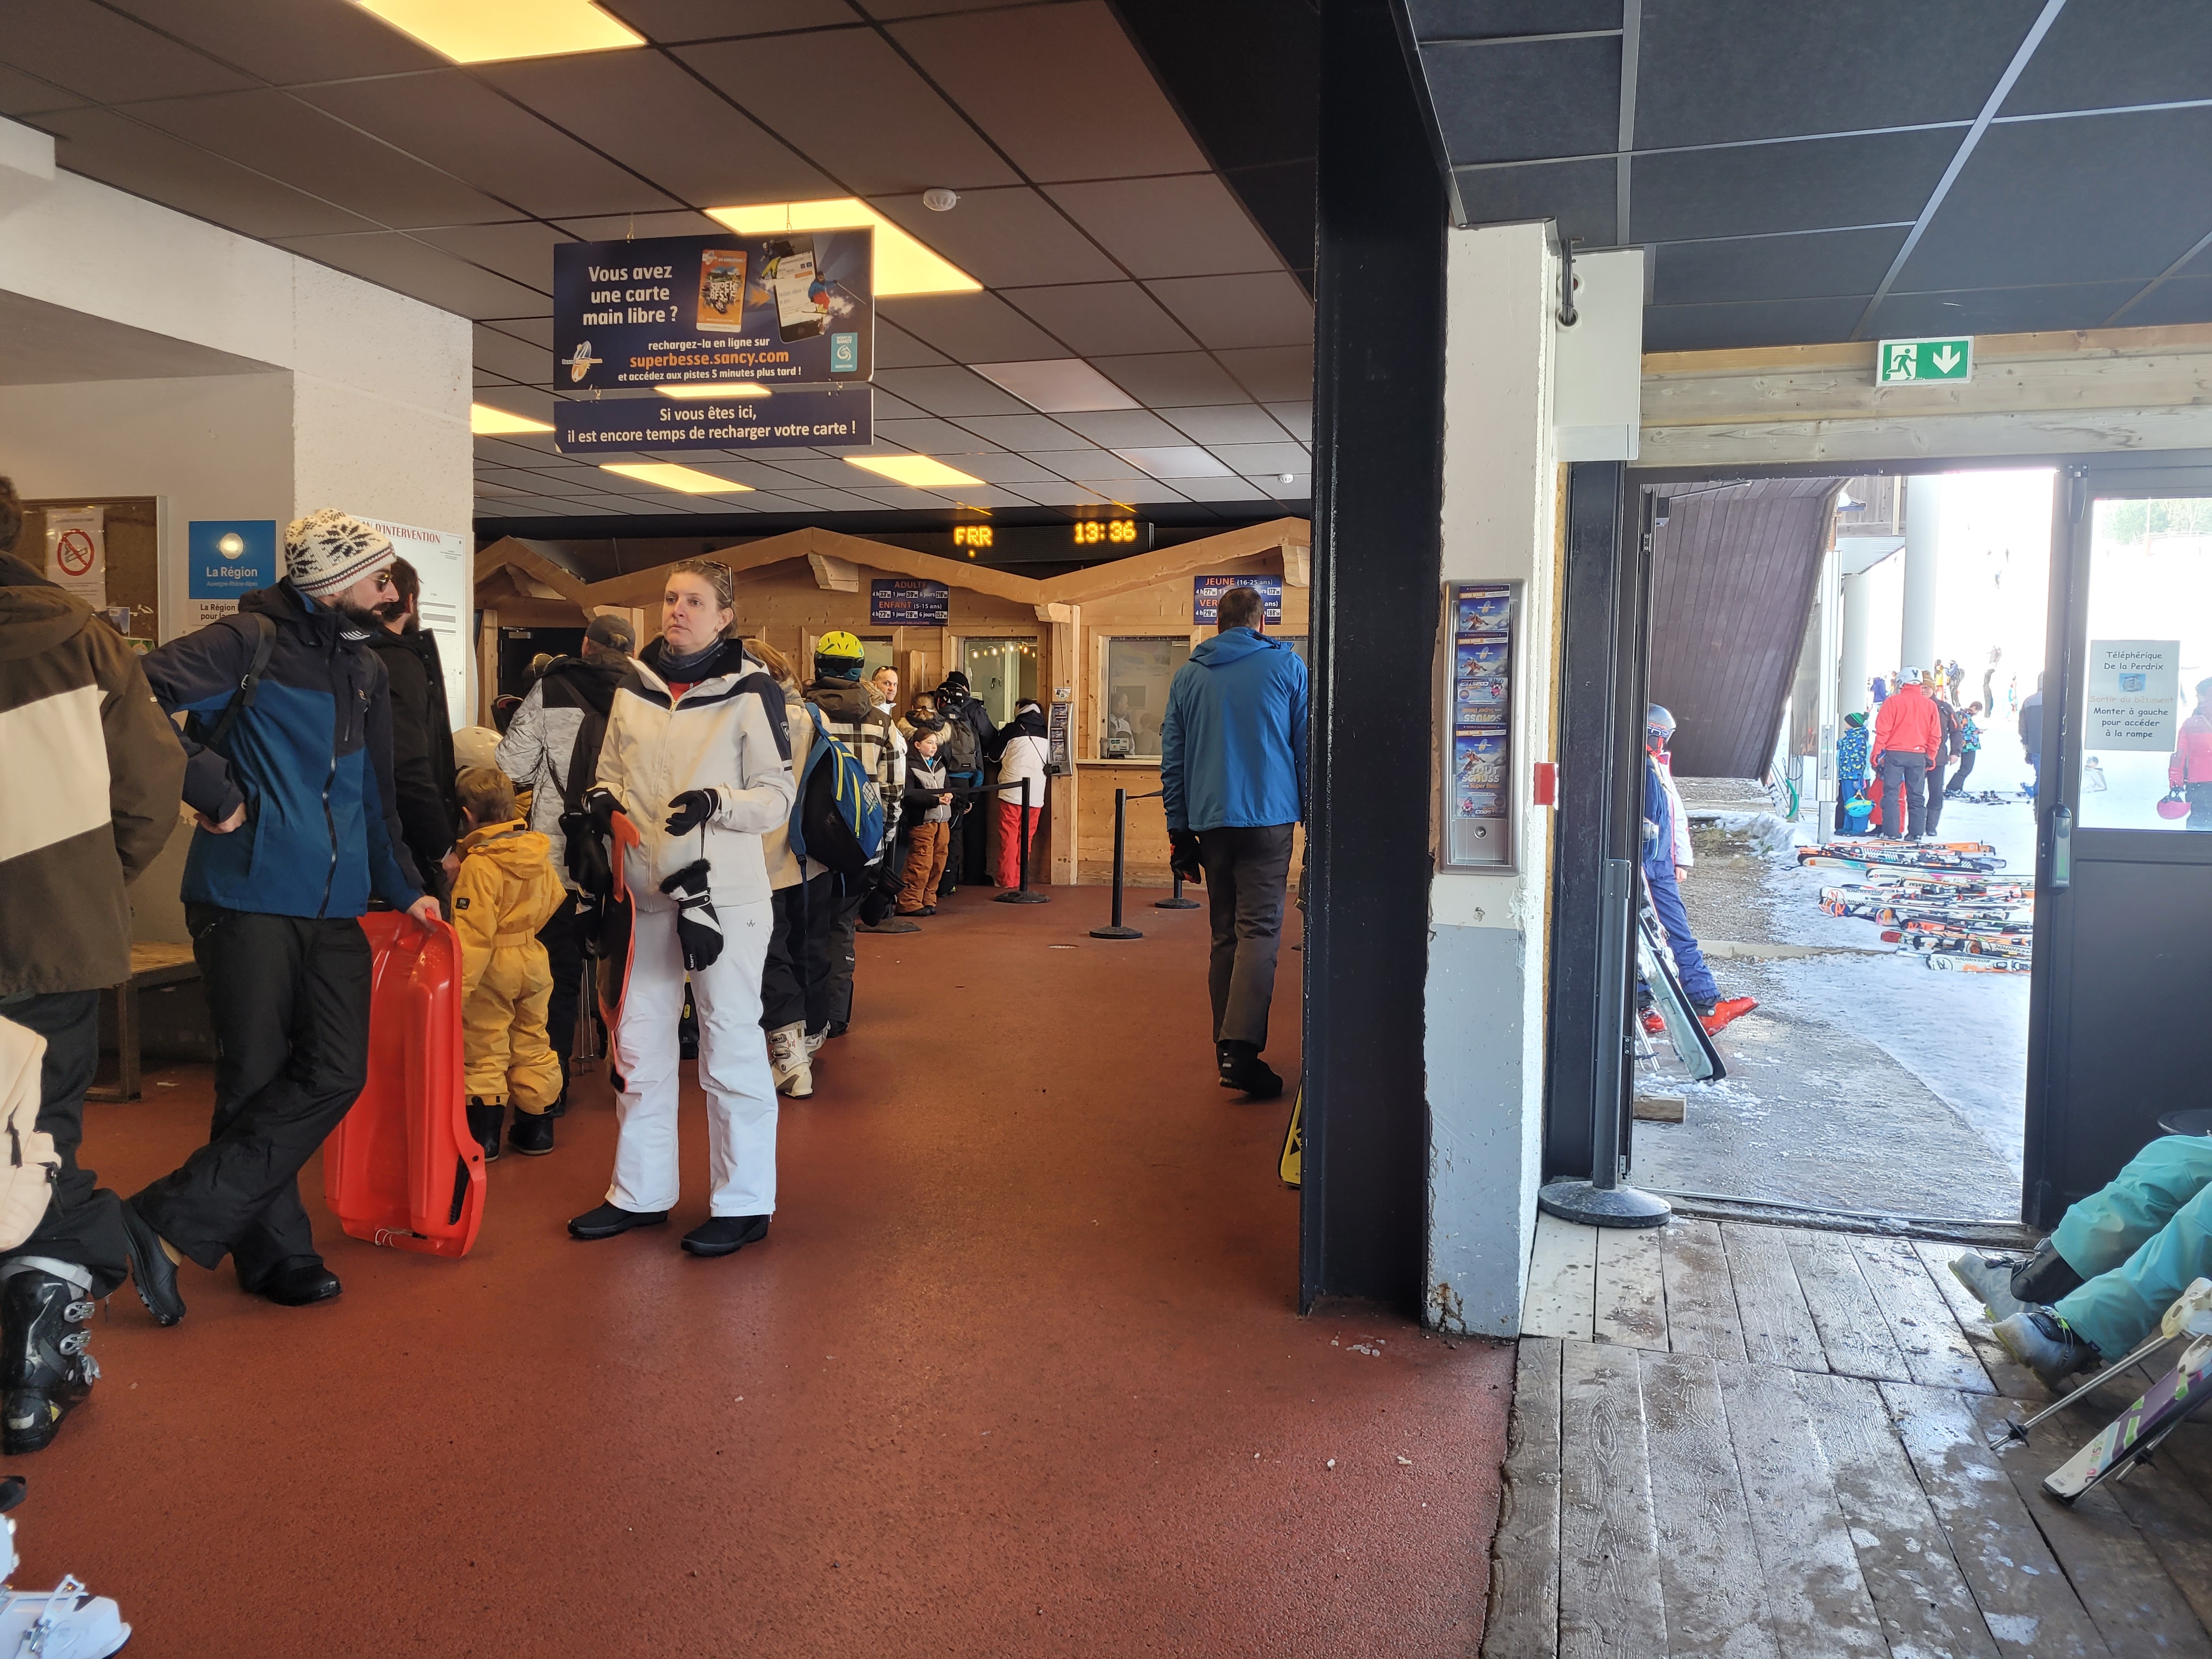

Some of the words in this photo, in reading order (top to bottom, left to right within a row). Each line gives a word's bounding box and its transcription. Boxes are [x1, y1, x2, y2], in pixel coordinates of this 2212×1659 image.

[588, 266, 628, 282] Vous
[633, 266, 672, 280] avez
[711, 281, 738, 291] SUPER
[591, 290, 621, 303] une
[625, 286, 670, 302] carte
[710, 290, 737, 302] BESSE
[583, 308, 623, 325] main
[628, 307, 665, 324] libre
[670, 306, 678, 321] ?
[648, 338, 711, 351] rechargez-la
[713, 341, 726, 349] en
[728, 338, 752, 349] ligne
[754, 337, 770, 347] sur
[630, 351, 789, 370] superbesse.sancy.com
[618, 373, 628, 381] et
[629, 370, 665, 381] accédez
[684, 370, 710, 381] pistes
[712, 369, 718, 379] 5
[719, 369, 754, 379] minutes
[757, 368, 775, 379] plus
[777, 366, 797, 376] tard
[798, 366, 802, 375] !
[660, 408, 670, 421] Si
[674, 409, 704, 421] vous
[708, 406, 735, 420] êtes
[738, 405, 757, 420] ici,
[567, 430, 575, 443] il
[578, 430, 597, 443] est
[600, 430, 643, 442] encore
[646, 428, 685, 443] temps
[689, 426, 705, 439] de
[709, 425, 770, 440] recharger
[774, 424, 809, 437] votre
[813, 422, 847, 435] carte
[851, 420, 856, 434] !
[375, 523, 440, 544] D'INTERVENTION
[1074, 520, 1136, 543] 13:36
[206, 567, 218, 577] La
[221, 566, 257, 579] Région
[211, 603, 235, 612] Région
[2106, 651, 2163, 661] Téléphérique
[1464, 714, 1502, 722] SCHUSS
[2138, 708, 2169, 716] gauche
[1470, 766, 1499, 775] TOUT
[1462, 774, 1500, 783] SCHUSS
[1994, 944, 2032, 953] OSSIGNOL
